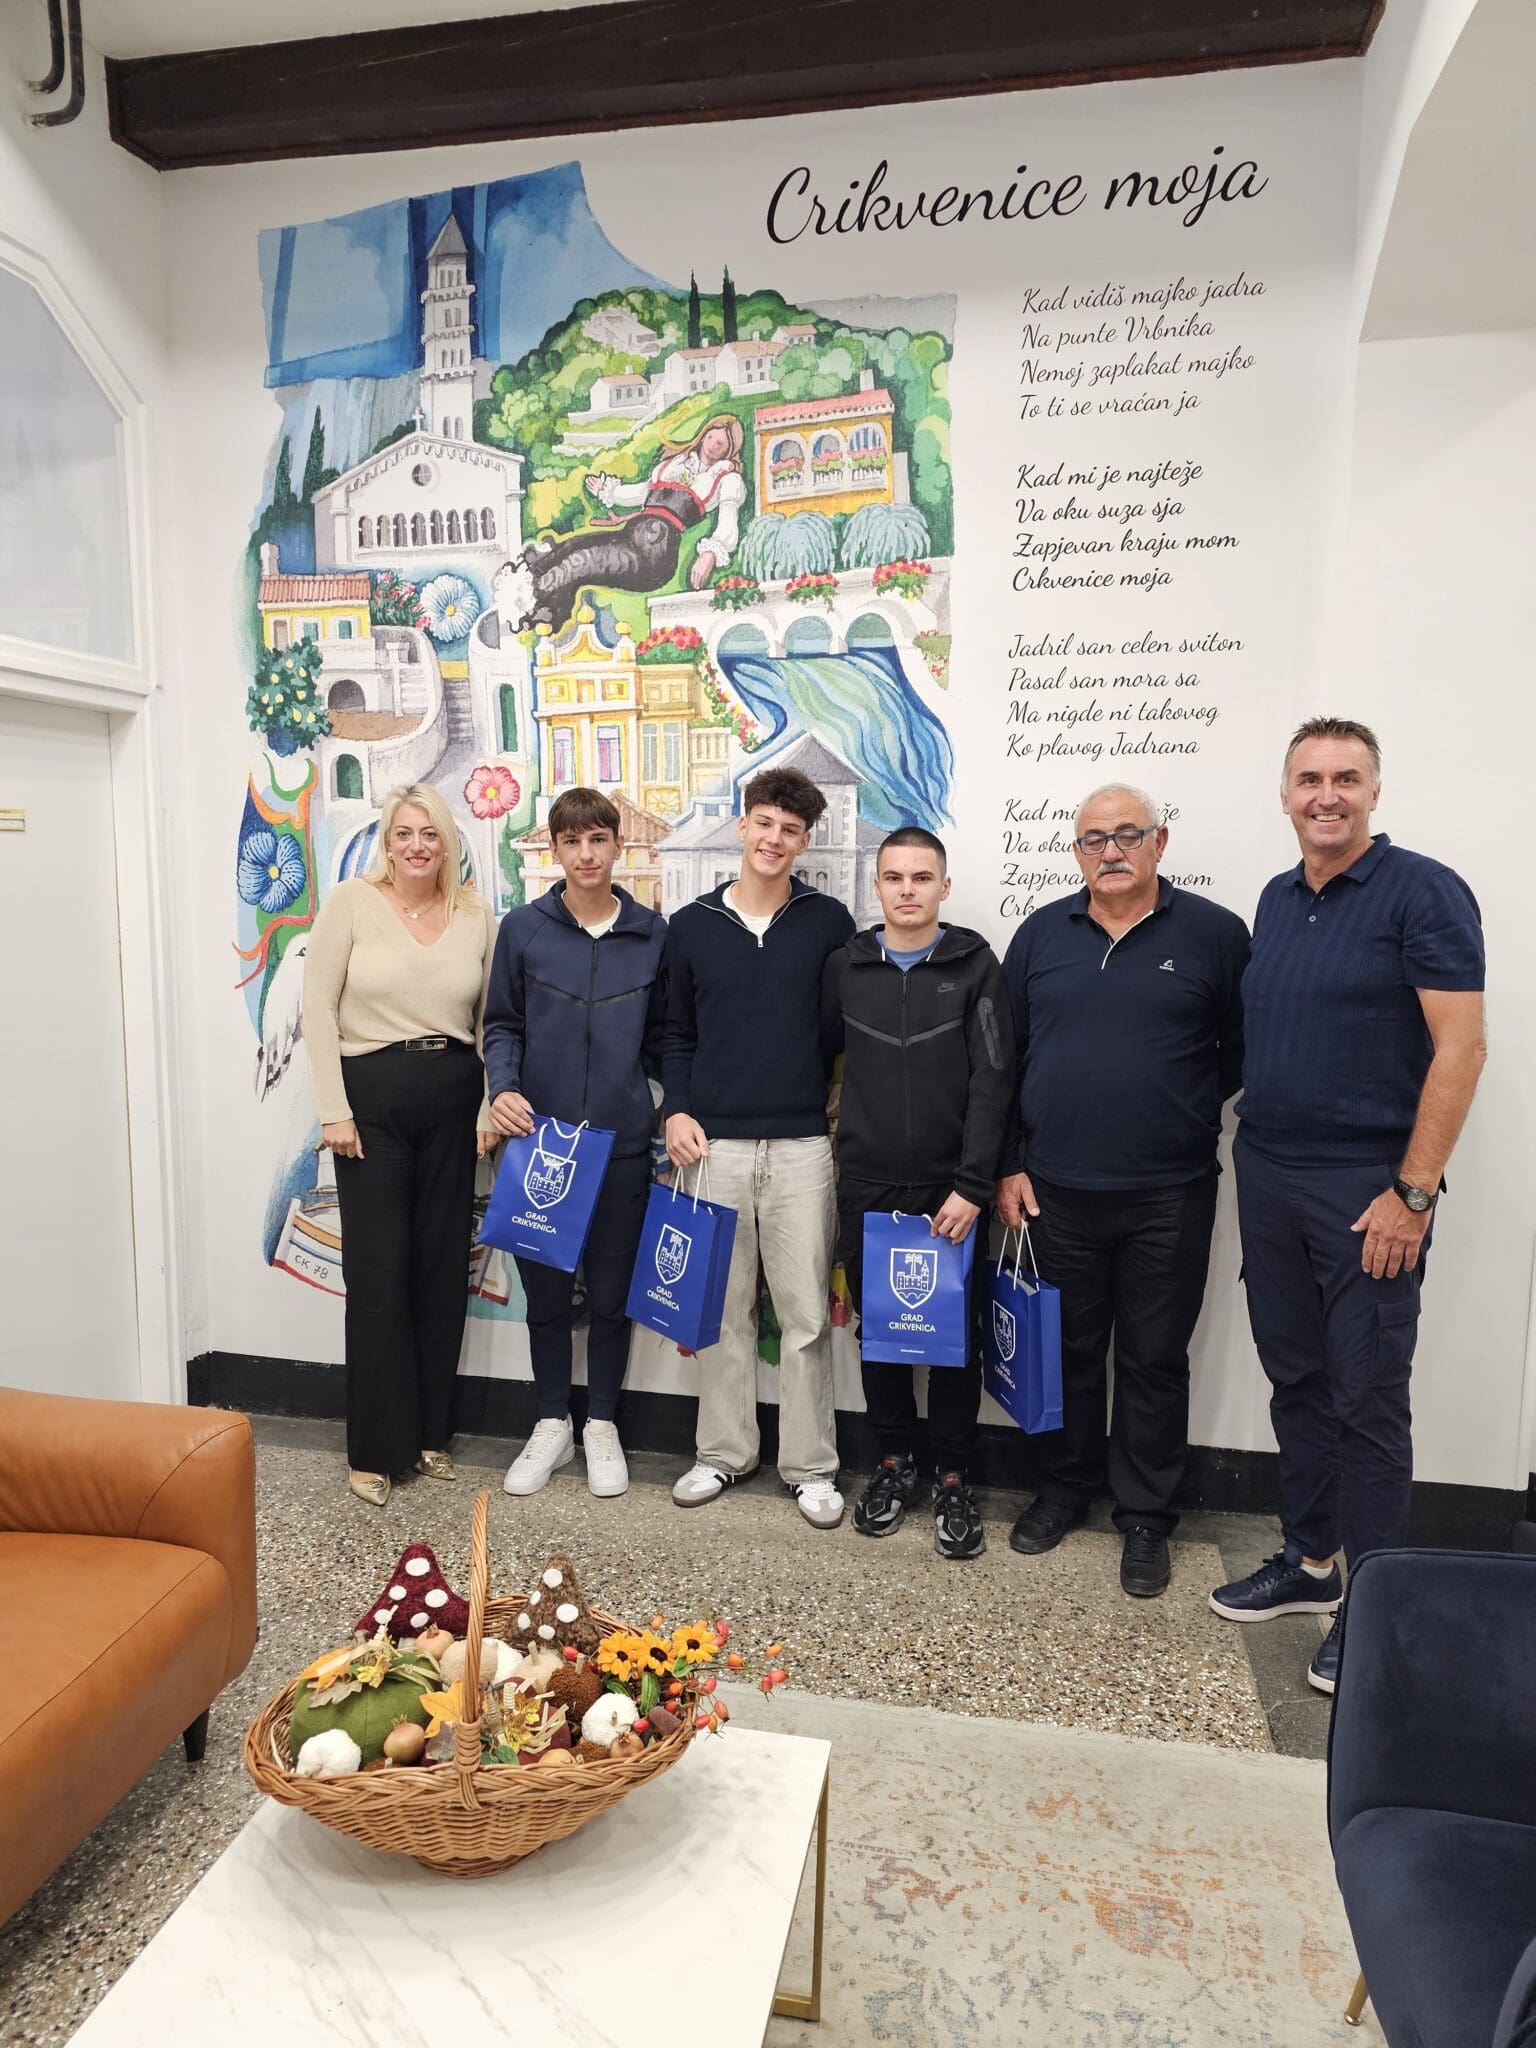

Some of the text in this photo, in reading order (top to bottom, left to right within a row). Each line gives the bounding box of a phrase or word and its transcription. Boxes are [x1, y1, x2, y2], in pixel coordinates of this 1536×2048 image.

[767, 146, 1269, 244] Crikvenice moja
[1022, 272, 1267, 314] Kad vidiš majko jadra
[1021, 312, 1215, 353] Na punte Vrbnika
[1020, 345, 1255, 388] Nemoj zaplakat majko
[1021, 391, 1201, 420] To ti se vraćan ja
[1016, 460, 1203, 491] Kad mi je najteže
[1016, 497, 1185, 524] Va oku suza sja
[1013, 528, 1240, 562] Zapjevan kraju mom
[1013, 566, 1173, 592] Crkvenice moja
[1008, 630, 1245, 658] Jadril san celen sviton
[1009, 666, 1200, 691] Pasal san mora sa
[1006, 697, 1220, 729] Ma nigde ni takovog
[1007, 731, 1200, 762] Ko plavog Jadrana
[1004, 799, 1047, 822] Kad
[1003, 830, 1032, 854] Va
[511, 1215, 557, 1235] CRIKVENICA
[525, 1211, 548, 1223] GRAD
[295, 1255, 310, 1269] CK
[656, 1285, 673, 1299] GRAD
[889, 1321, 936, 1332] CRIKVENICA
[900, 1313, 924, 1322] GRAD
